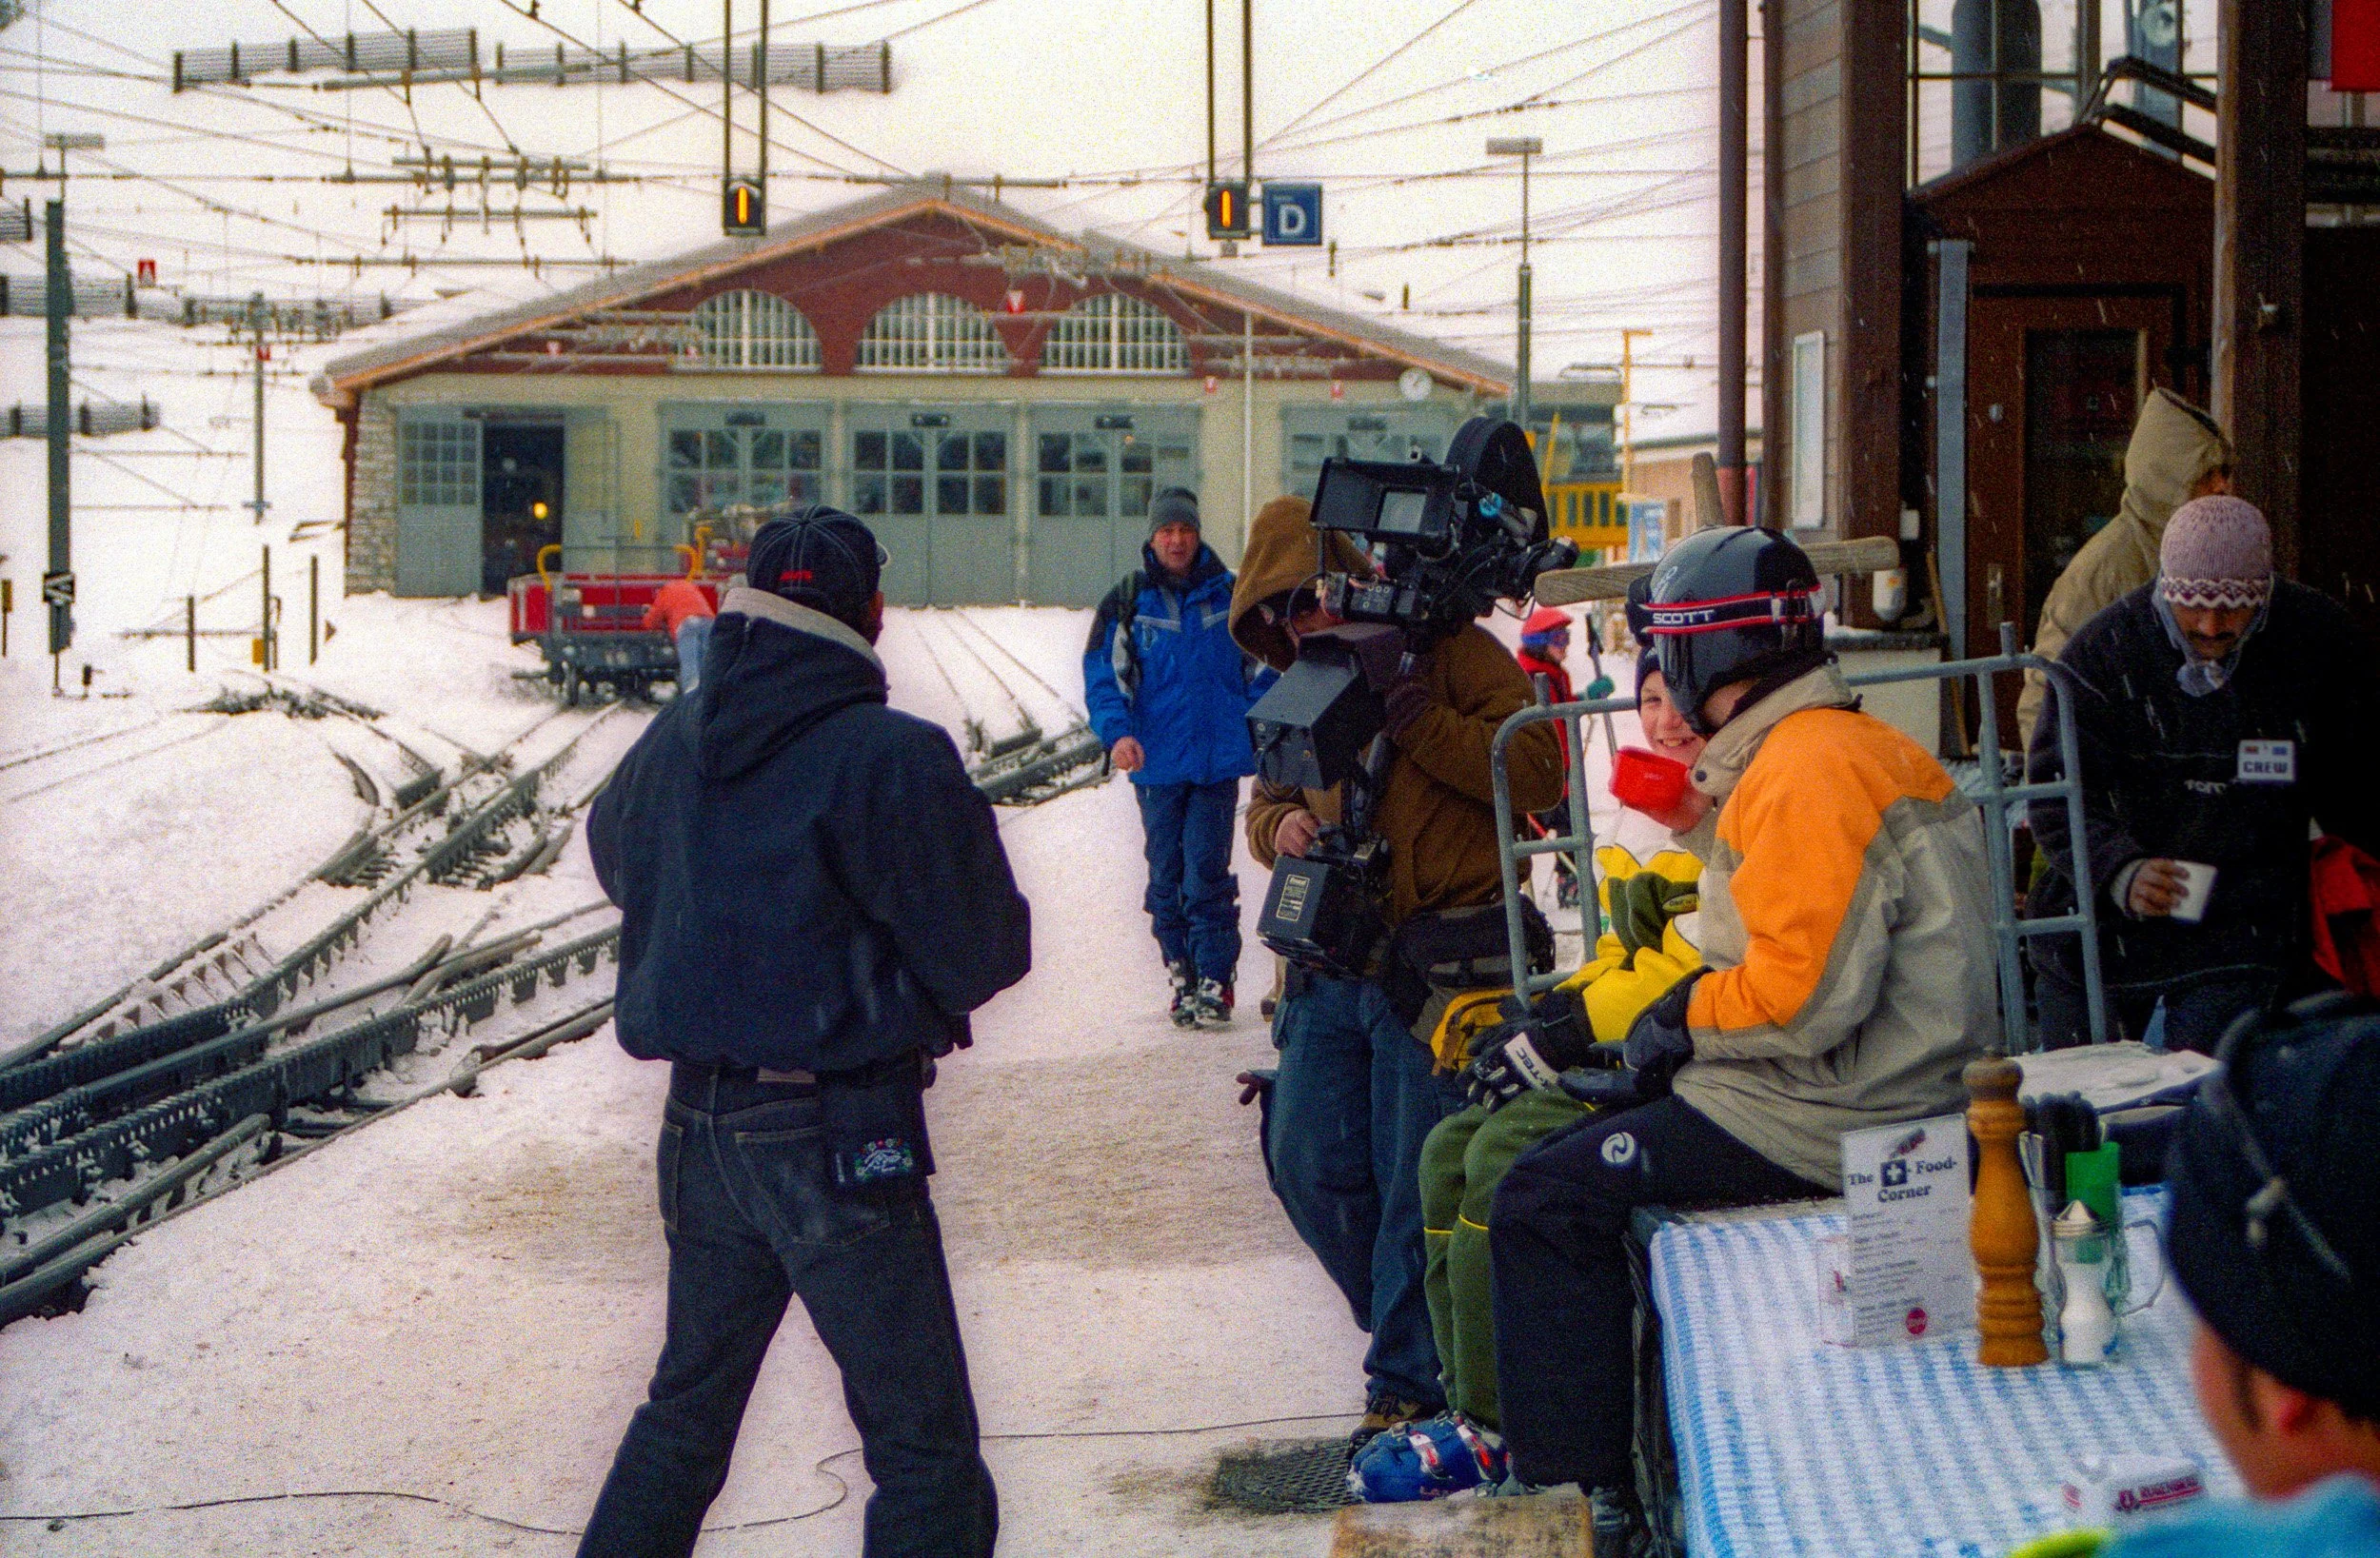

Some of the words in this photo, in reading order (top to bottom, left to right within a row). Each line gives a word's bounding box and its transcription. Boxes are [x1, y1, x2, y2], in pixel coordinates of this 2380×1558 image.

[1279, 204, 1306, 236] D
[1653, 610, 1715, 623] SCOTT
[2243, 761, 2288, 773] CREW
[1848, 1172, 1874, 1186] The
[1877, 1185, 1932, 1203] Corner
